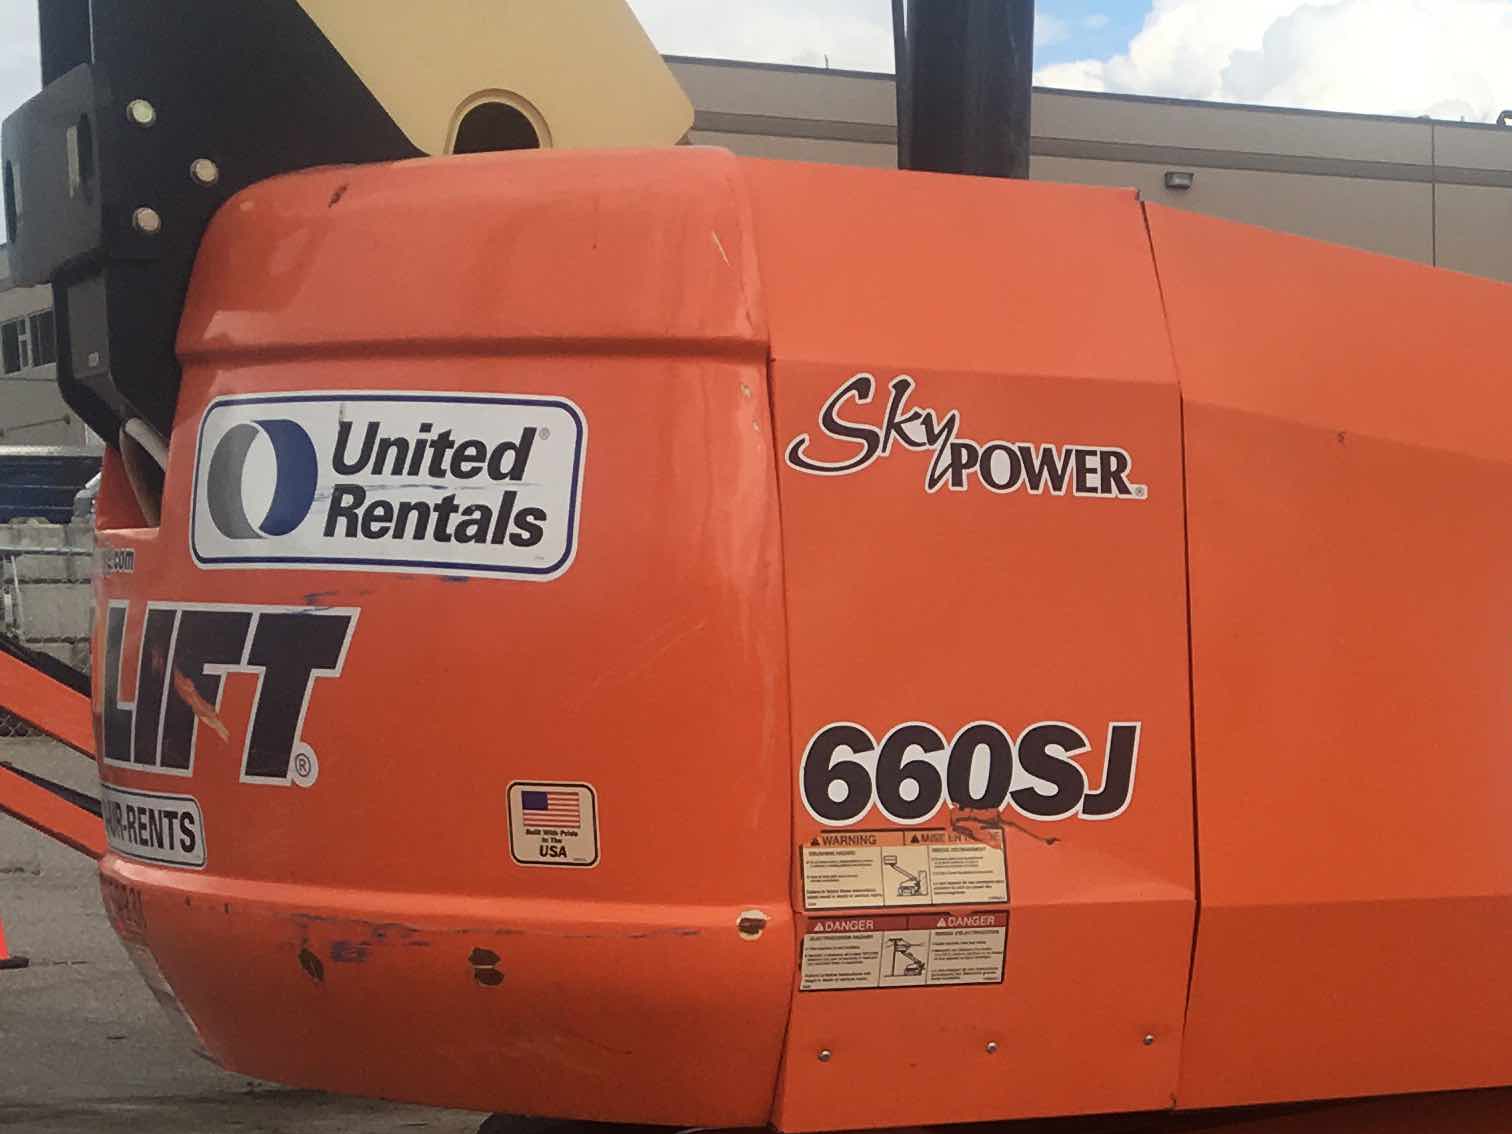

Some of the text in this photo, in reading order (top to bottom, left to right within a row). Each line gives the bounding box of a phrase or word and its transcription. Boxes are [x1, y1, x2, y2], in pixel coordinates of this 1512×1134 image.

[332, 420, 537, 481] United
[787, 374, 1133, 496] Sky POWER
[323, 483, 548, 548] Rentals
[103, 601, 361, 785] LIFT
[802, 722, 1140, 824] 660SJ
[540, 844, 567, 858] USA
[560, 829, 579, 837] Pride
[821, 833, 877, 846] WARNING
[824, 919, 875, 932] DANGER
[947, 915, 996, 927] DANGER
